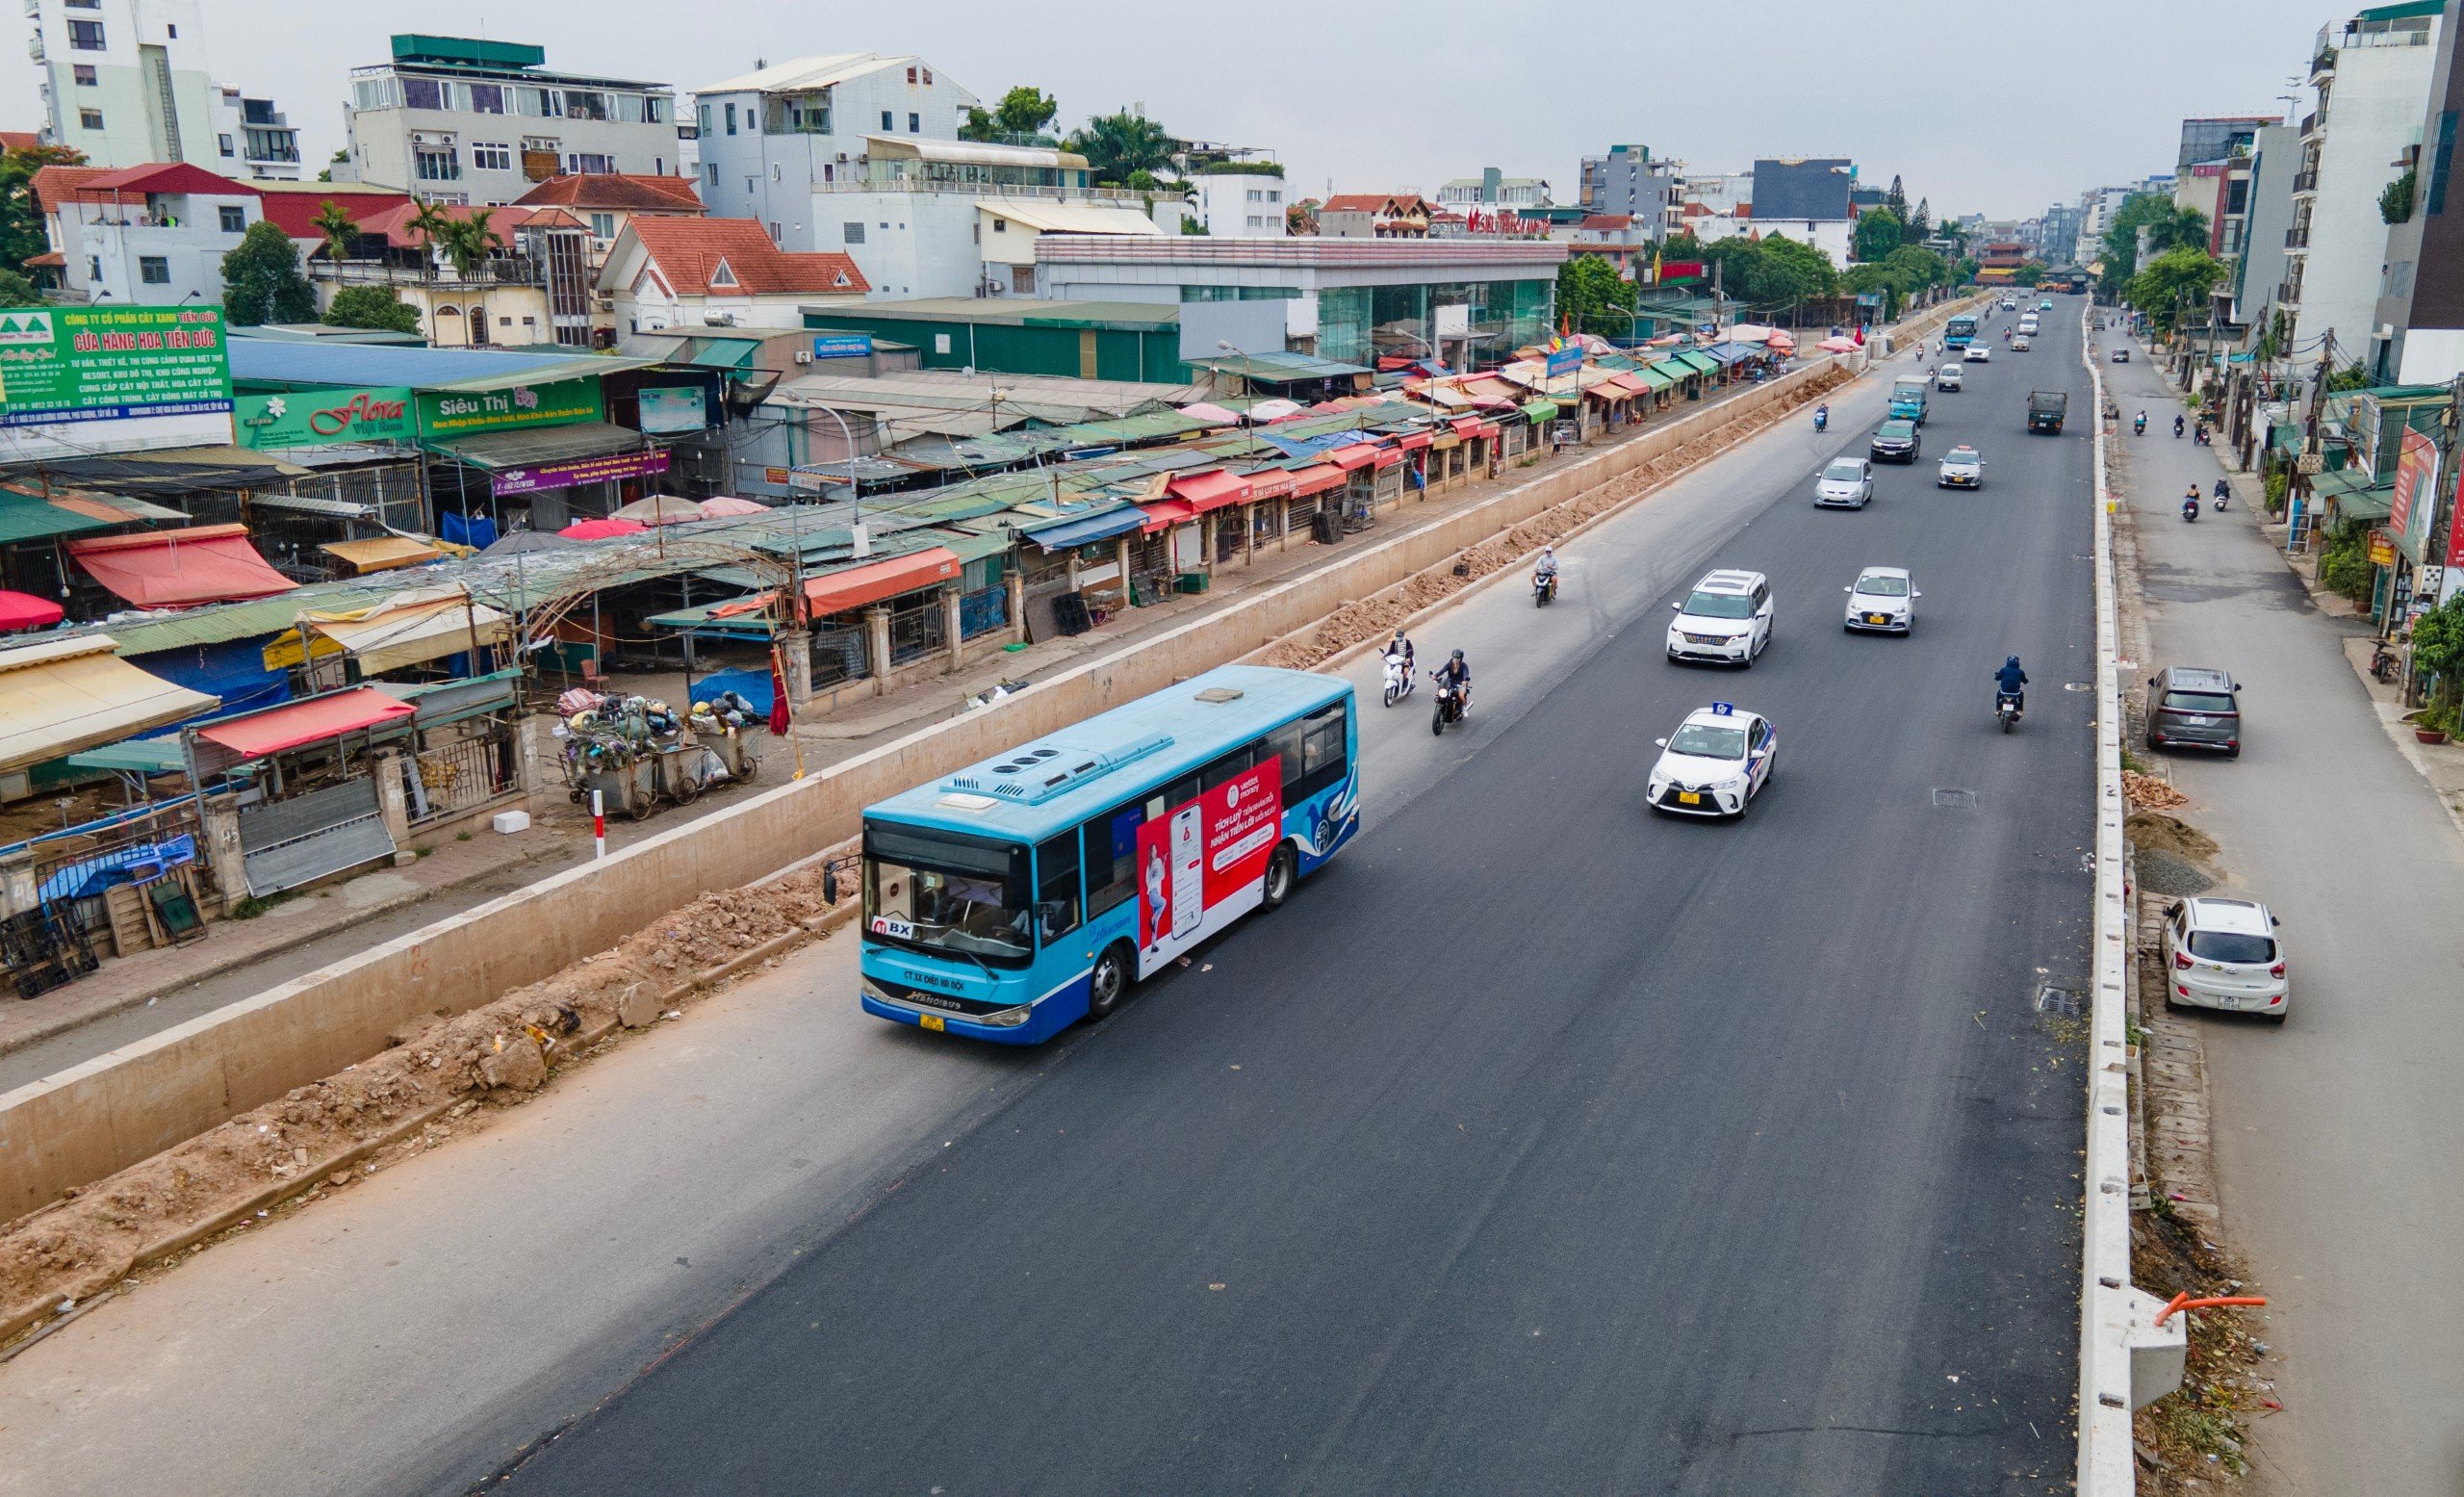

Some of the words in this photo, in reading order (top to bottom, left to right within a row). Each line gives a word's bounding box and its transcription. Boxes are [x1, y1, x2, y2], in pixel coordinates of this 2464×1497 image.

[74, 327, 101, 352] CỬA
[102, 329, 136, 350] HÀNG
[139, 331, 164, 350] HOA
[192, 326, 217, 348] ĐỨC
[440, 399, 478, 416] Siêu
[483, 395, 508, 414] Thị
[310, 393, 407, 435] Flora
[352, 422, 377, 437] Việt
[378, 421, 403, 433] Nam
[432, 420, 448, 428] Hoa
[1241, 784, 1259, 799] money
[1215, 818, 1229, 832] TÍCH
[221, 826, 240, 844] 45
[1211, 831, 1229, 848] NHẬN
[13, 880, 36, 907] 46
[890, 922, 910, 935] BX
[905, 971, 912, 980] CT
[915, 973, 922, 982] XE
